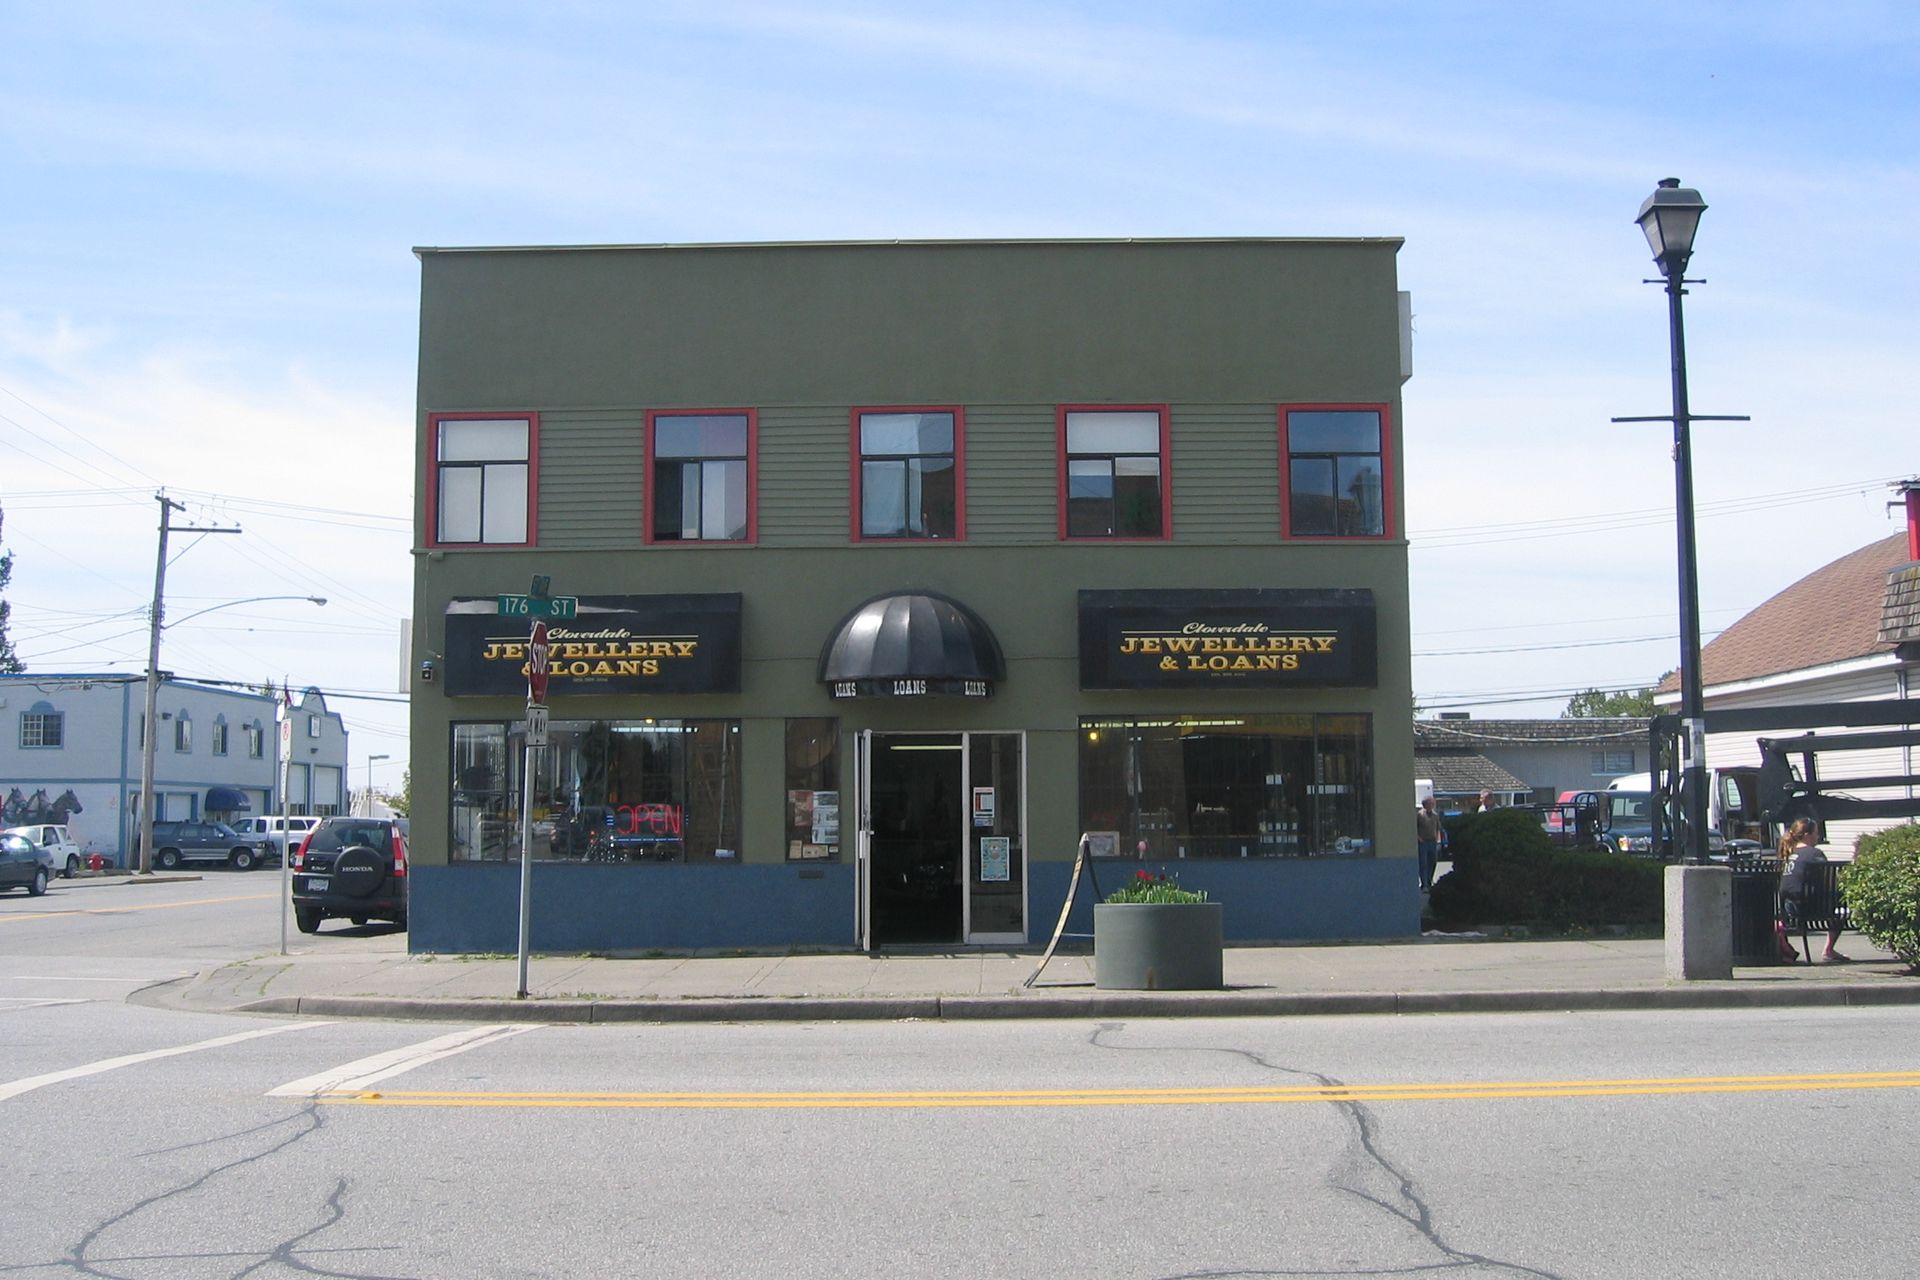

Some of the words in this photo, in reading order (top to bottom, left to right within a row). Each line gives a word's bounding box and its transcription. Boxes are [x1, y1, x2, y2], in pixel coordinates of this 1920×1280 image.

[505, 598, 529, 614] 176
[551, 600, 570, 616] ST
[546, 628, 631, 640] Cloverdale
[1182, 622, 1269, 635] Cloverdale
[1120, 636, 1337, 654] JEWELLERY
[549, 659, 660, 676] LOANS
[1159, 654, 1180, 671] &
[1187, 654, 1299, 671] LOANS
[835, 682, 857, 697] LOANS
[894, 680, 927, 695] LOANS
[965, 681, 986, 696] LOANS
